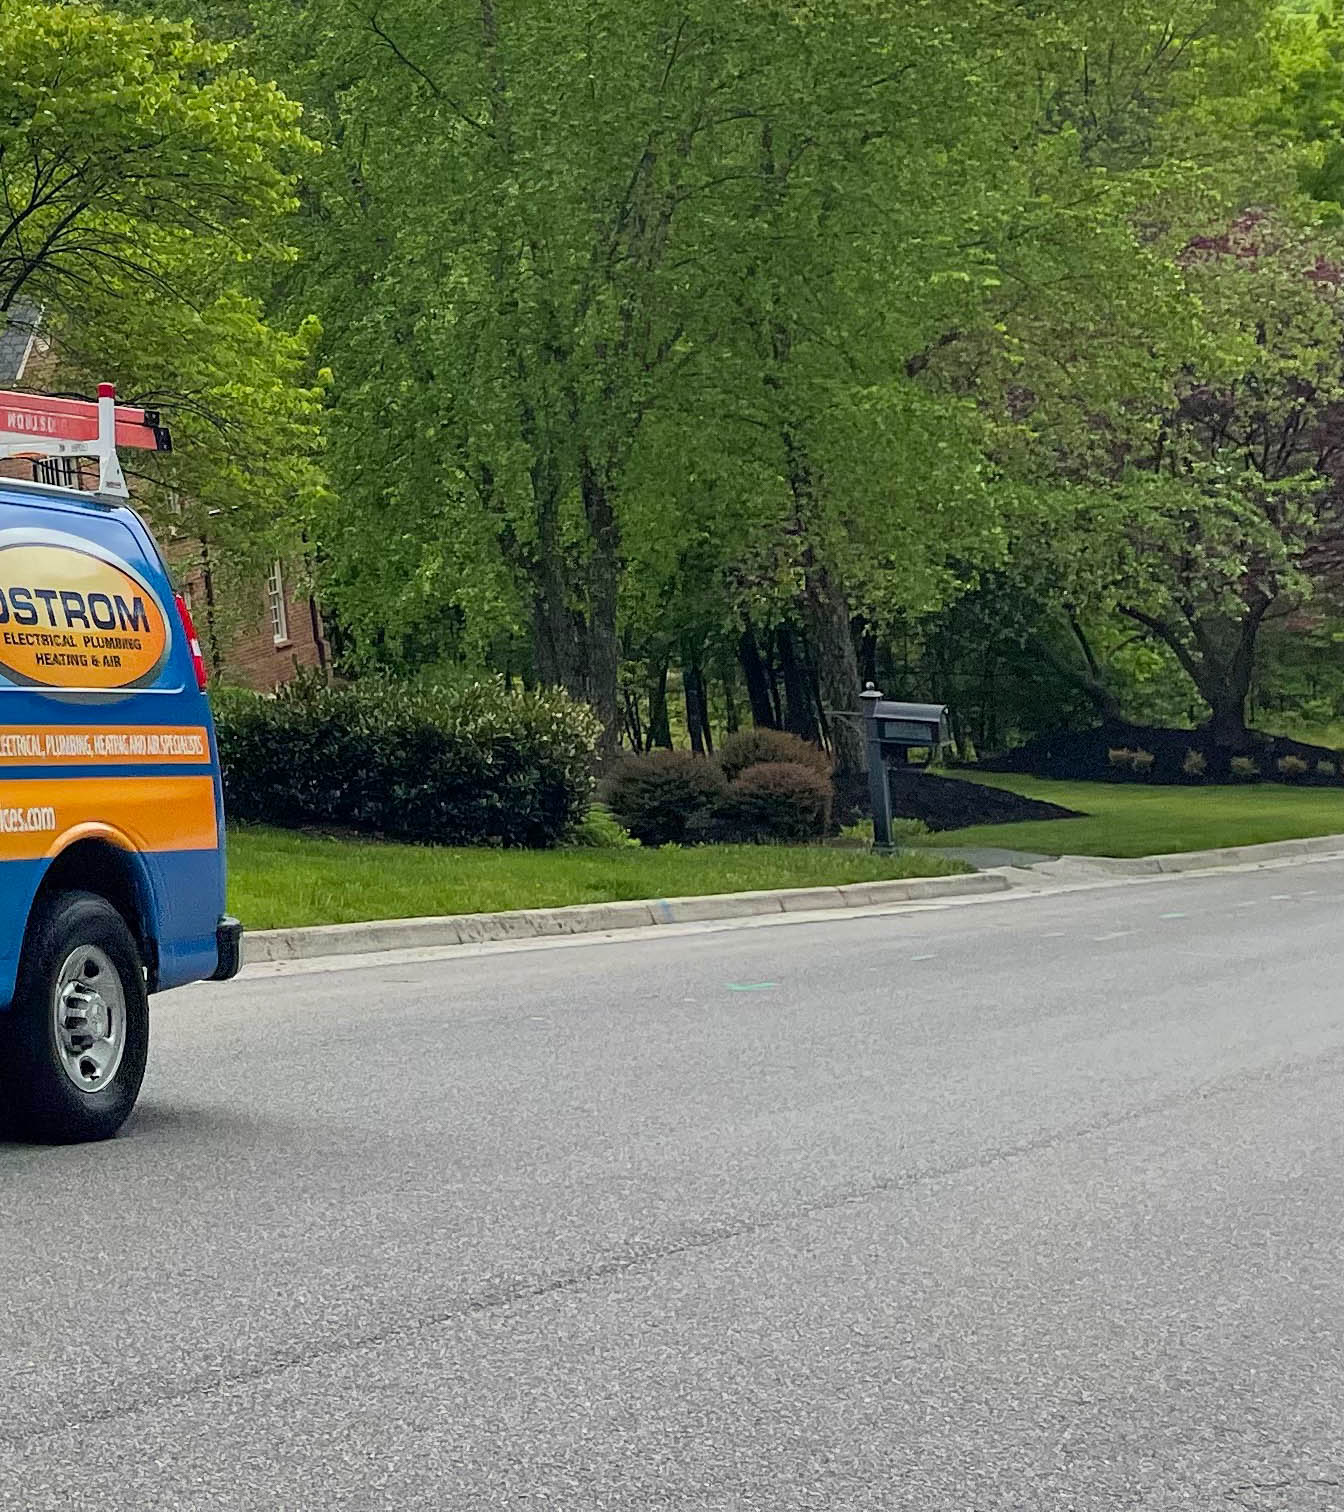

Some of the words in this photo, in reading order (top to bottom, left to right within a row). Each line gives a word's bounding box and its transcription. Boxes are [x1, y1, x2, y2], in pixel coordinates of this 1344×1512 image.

[3, 632, 77, 648] ELECTRICAL
[83, 635, 142, 651] PLUMBING
[35, 652, 88, 667] HEATING
[91, 655, 100, 667] &
[103, 655, 122, 668] AIR
[46, 734, 94, 758] PLUMBING,
[94, 734, 128, 756] HEATING
[129, 734, 146, 755] AND
[147, 734, 160, 755] AIR
[160, 734, 204, 755] SPECIALISTS
